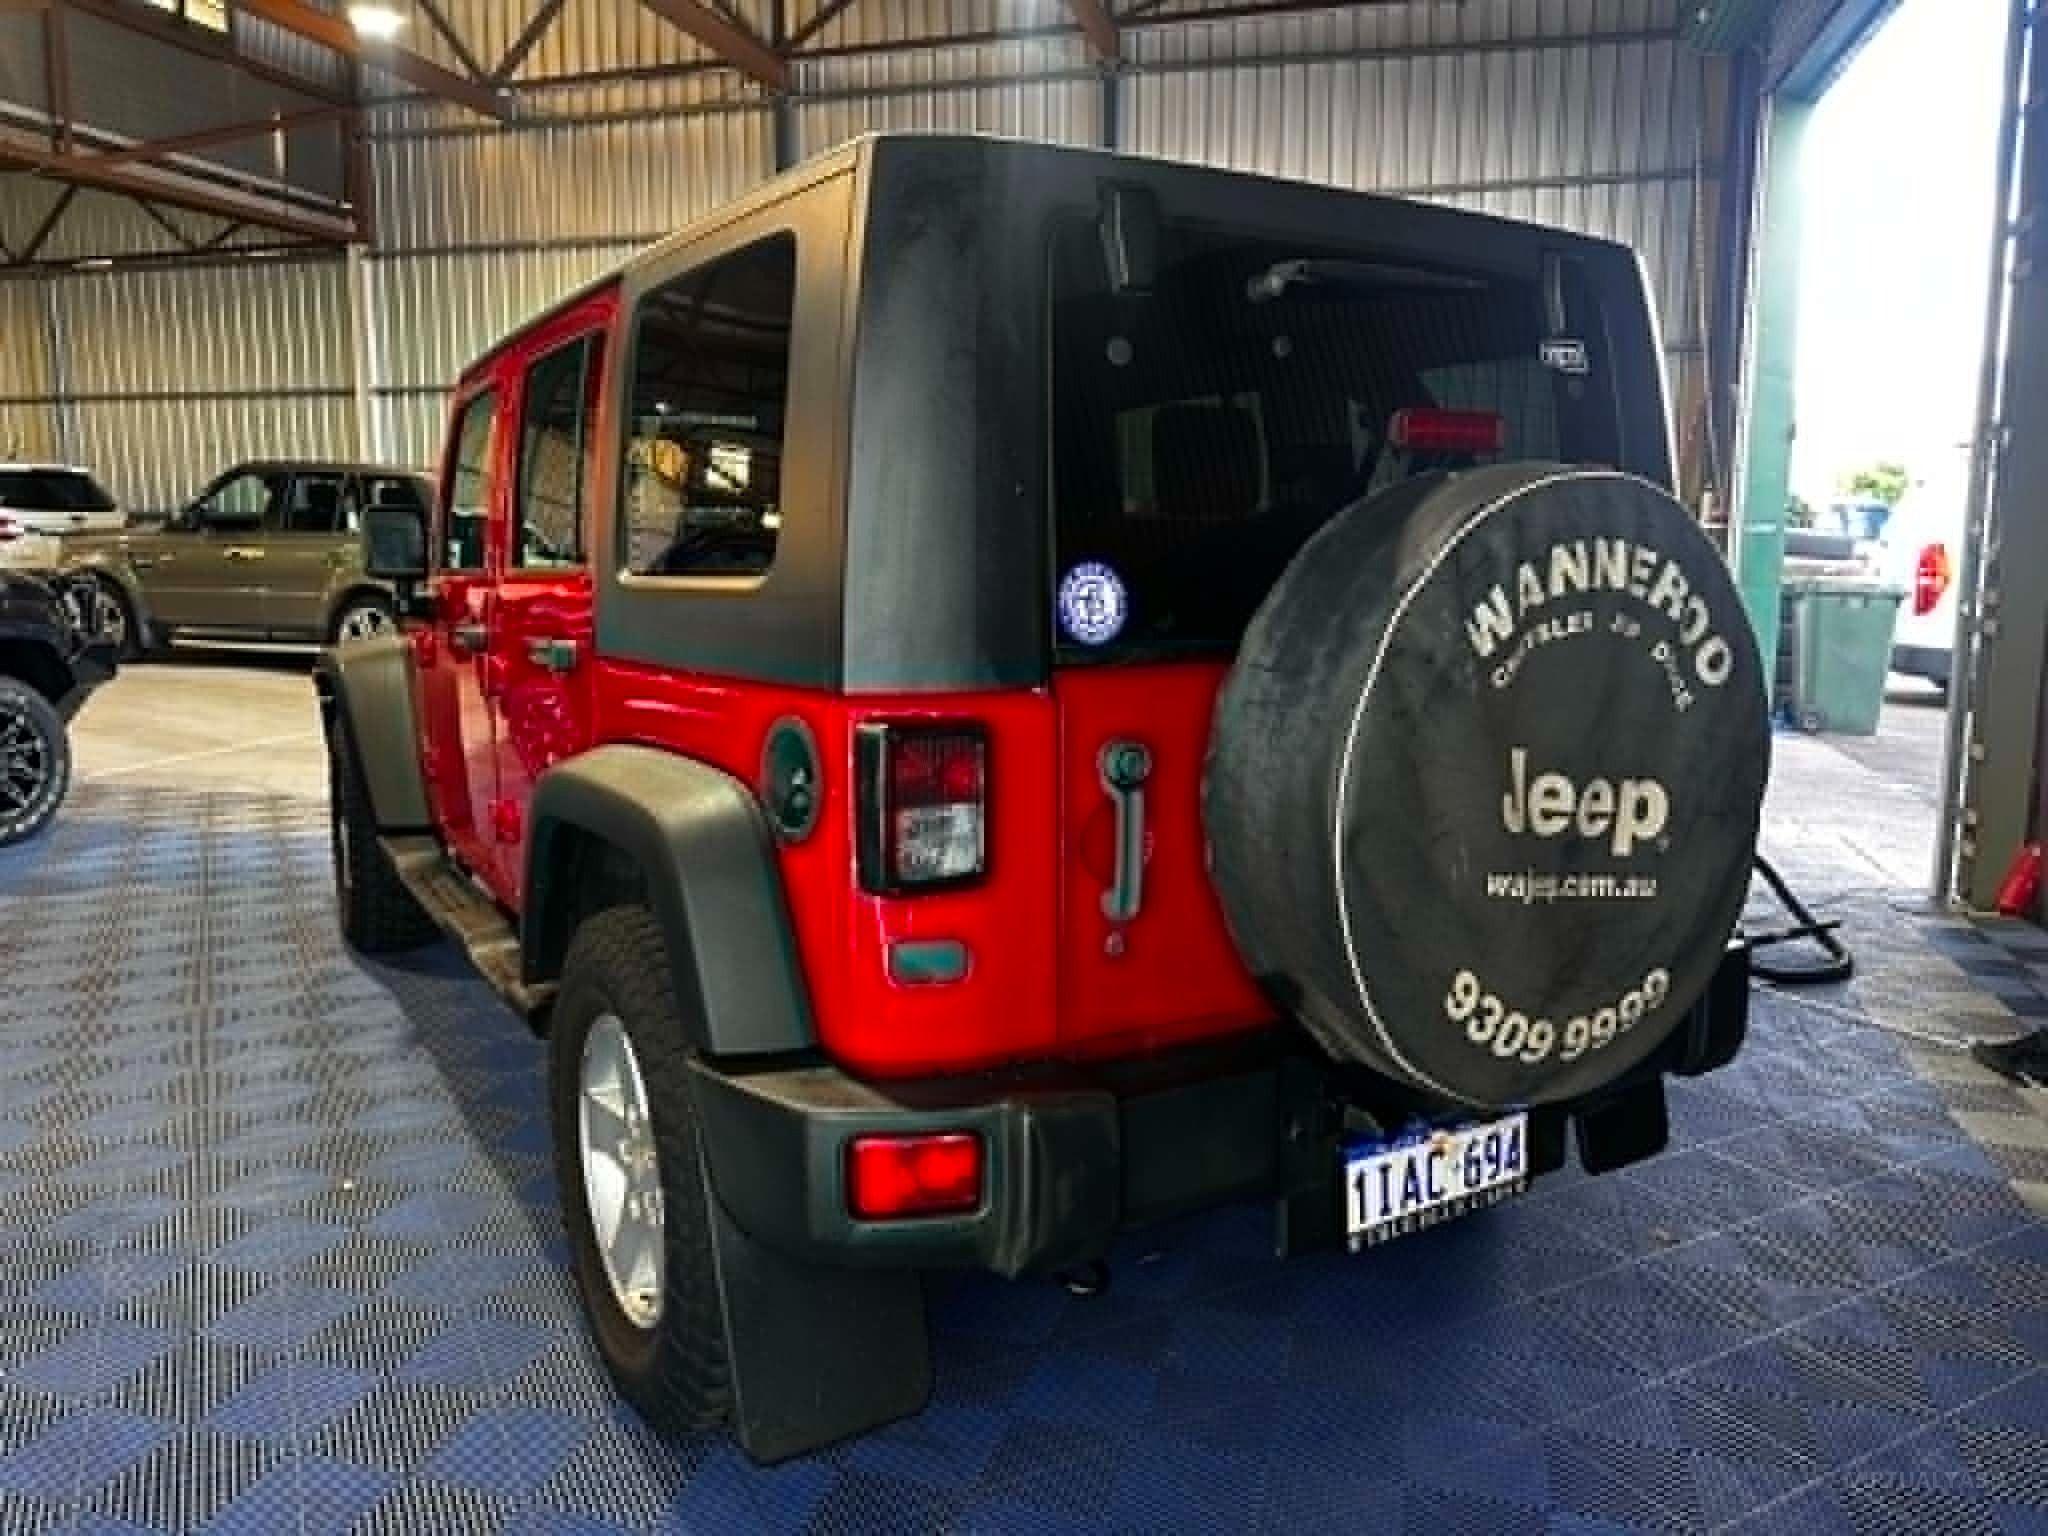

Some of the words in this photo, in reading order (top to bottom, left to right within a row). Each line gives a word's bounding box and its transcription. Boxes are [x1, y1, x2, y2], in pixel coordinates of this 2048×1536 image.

[1464, 536, 1733, 688] WANNEROO
[1503, 747, 1670, 856] Jeep
[1446, 969, 1553, 1063] 9309
[1560, 967, 1669, 1062] 9999
